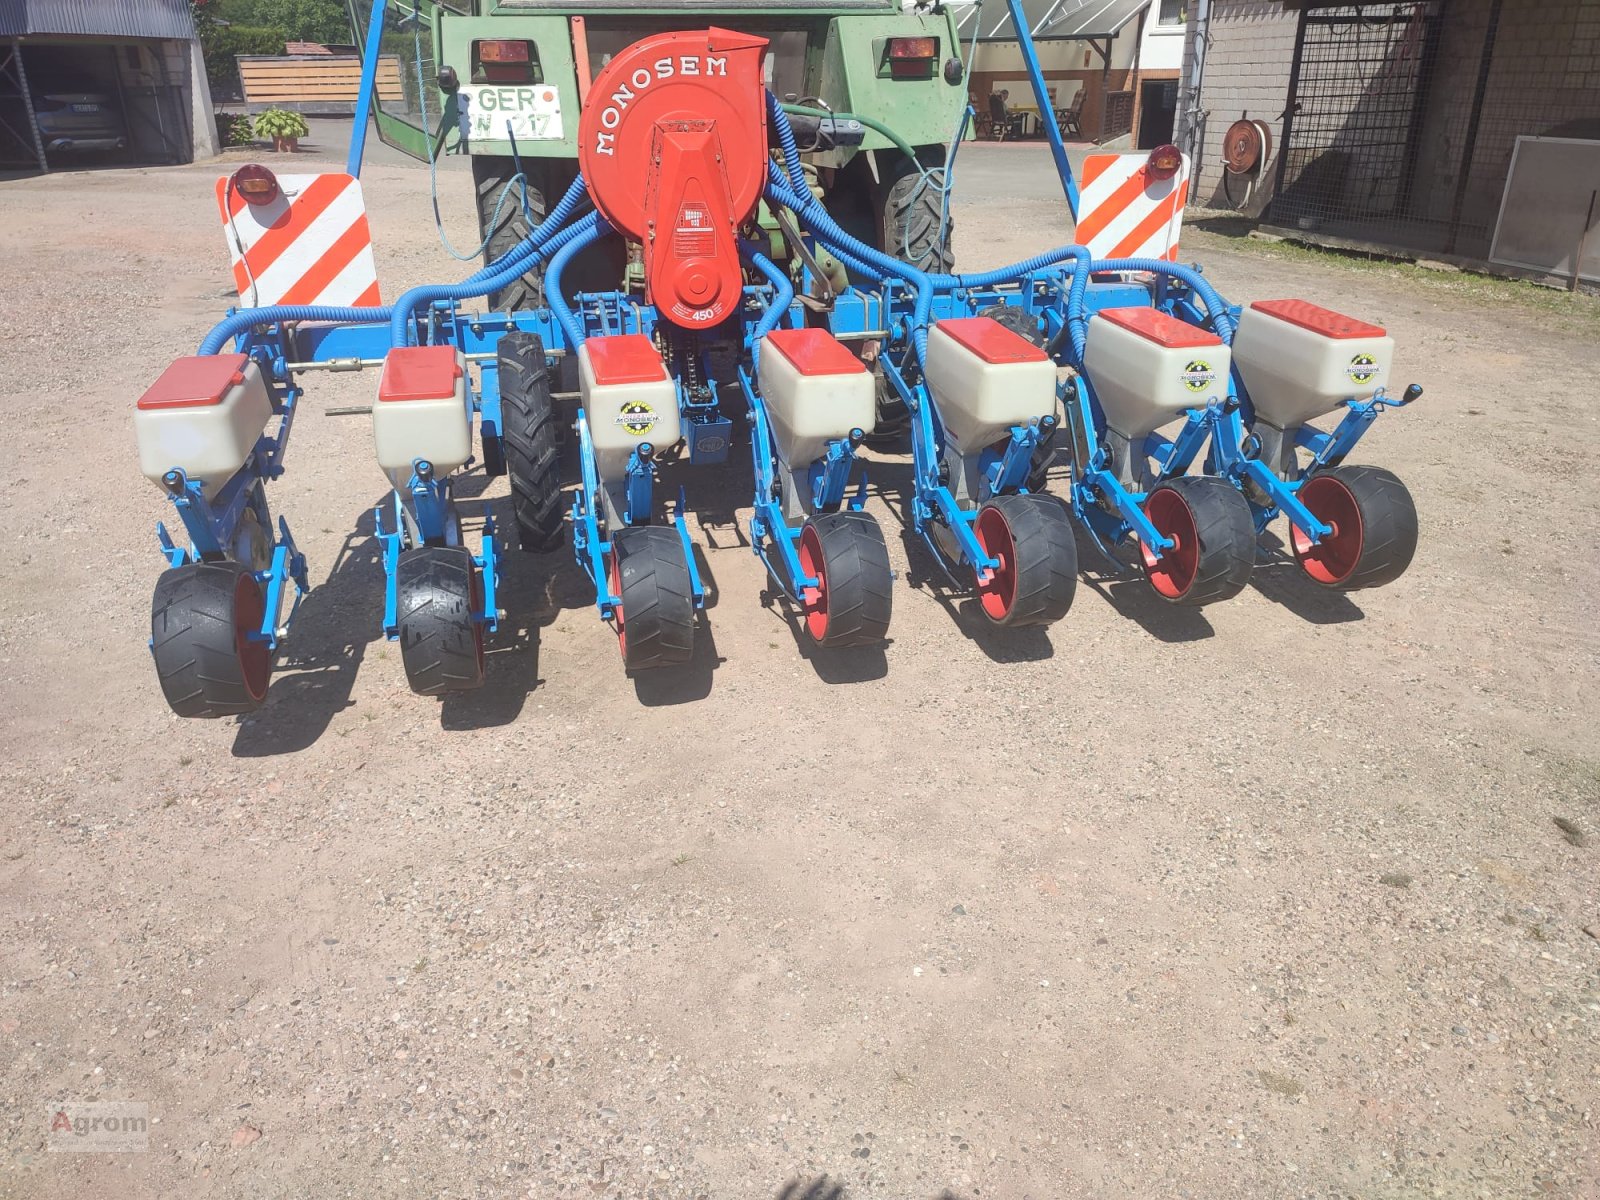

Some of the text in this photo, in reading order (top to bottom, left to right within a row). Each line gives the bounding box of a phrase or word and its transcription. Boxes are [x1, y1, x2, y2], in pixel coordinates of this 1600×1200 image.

[478, 88, 536, 111] GER
[596, 56, 727, 156] MONOSEM
[511, 112, 552, 137] 217
[692, 308, 714, 321] 450
